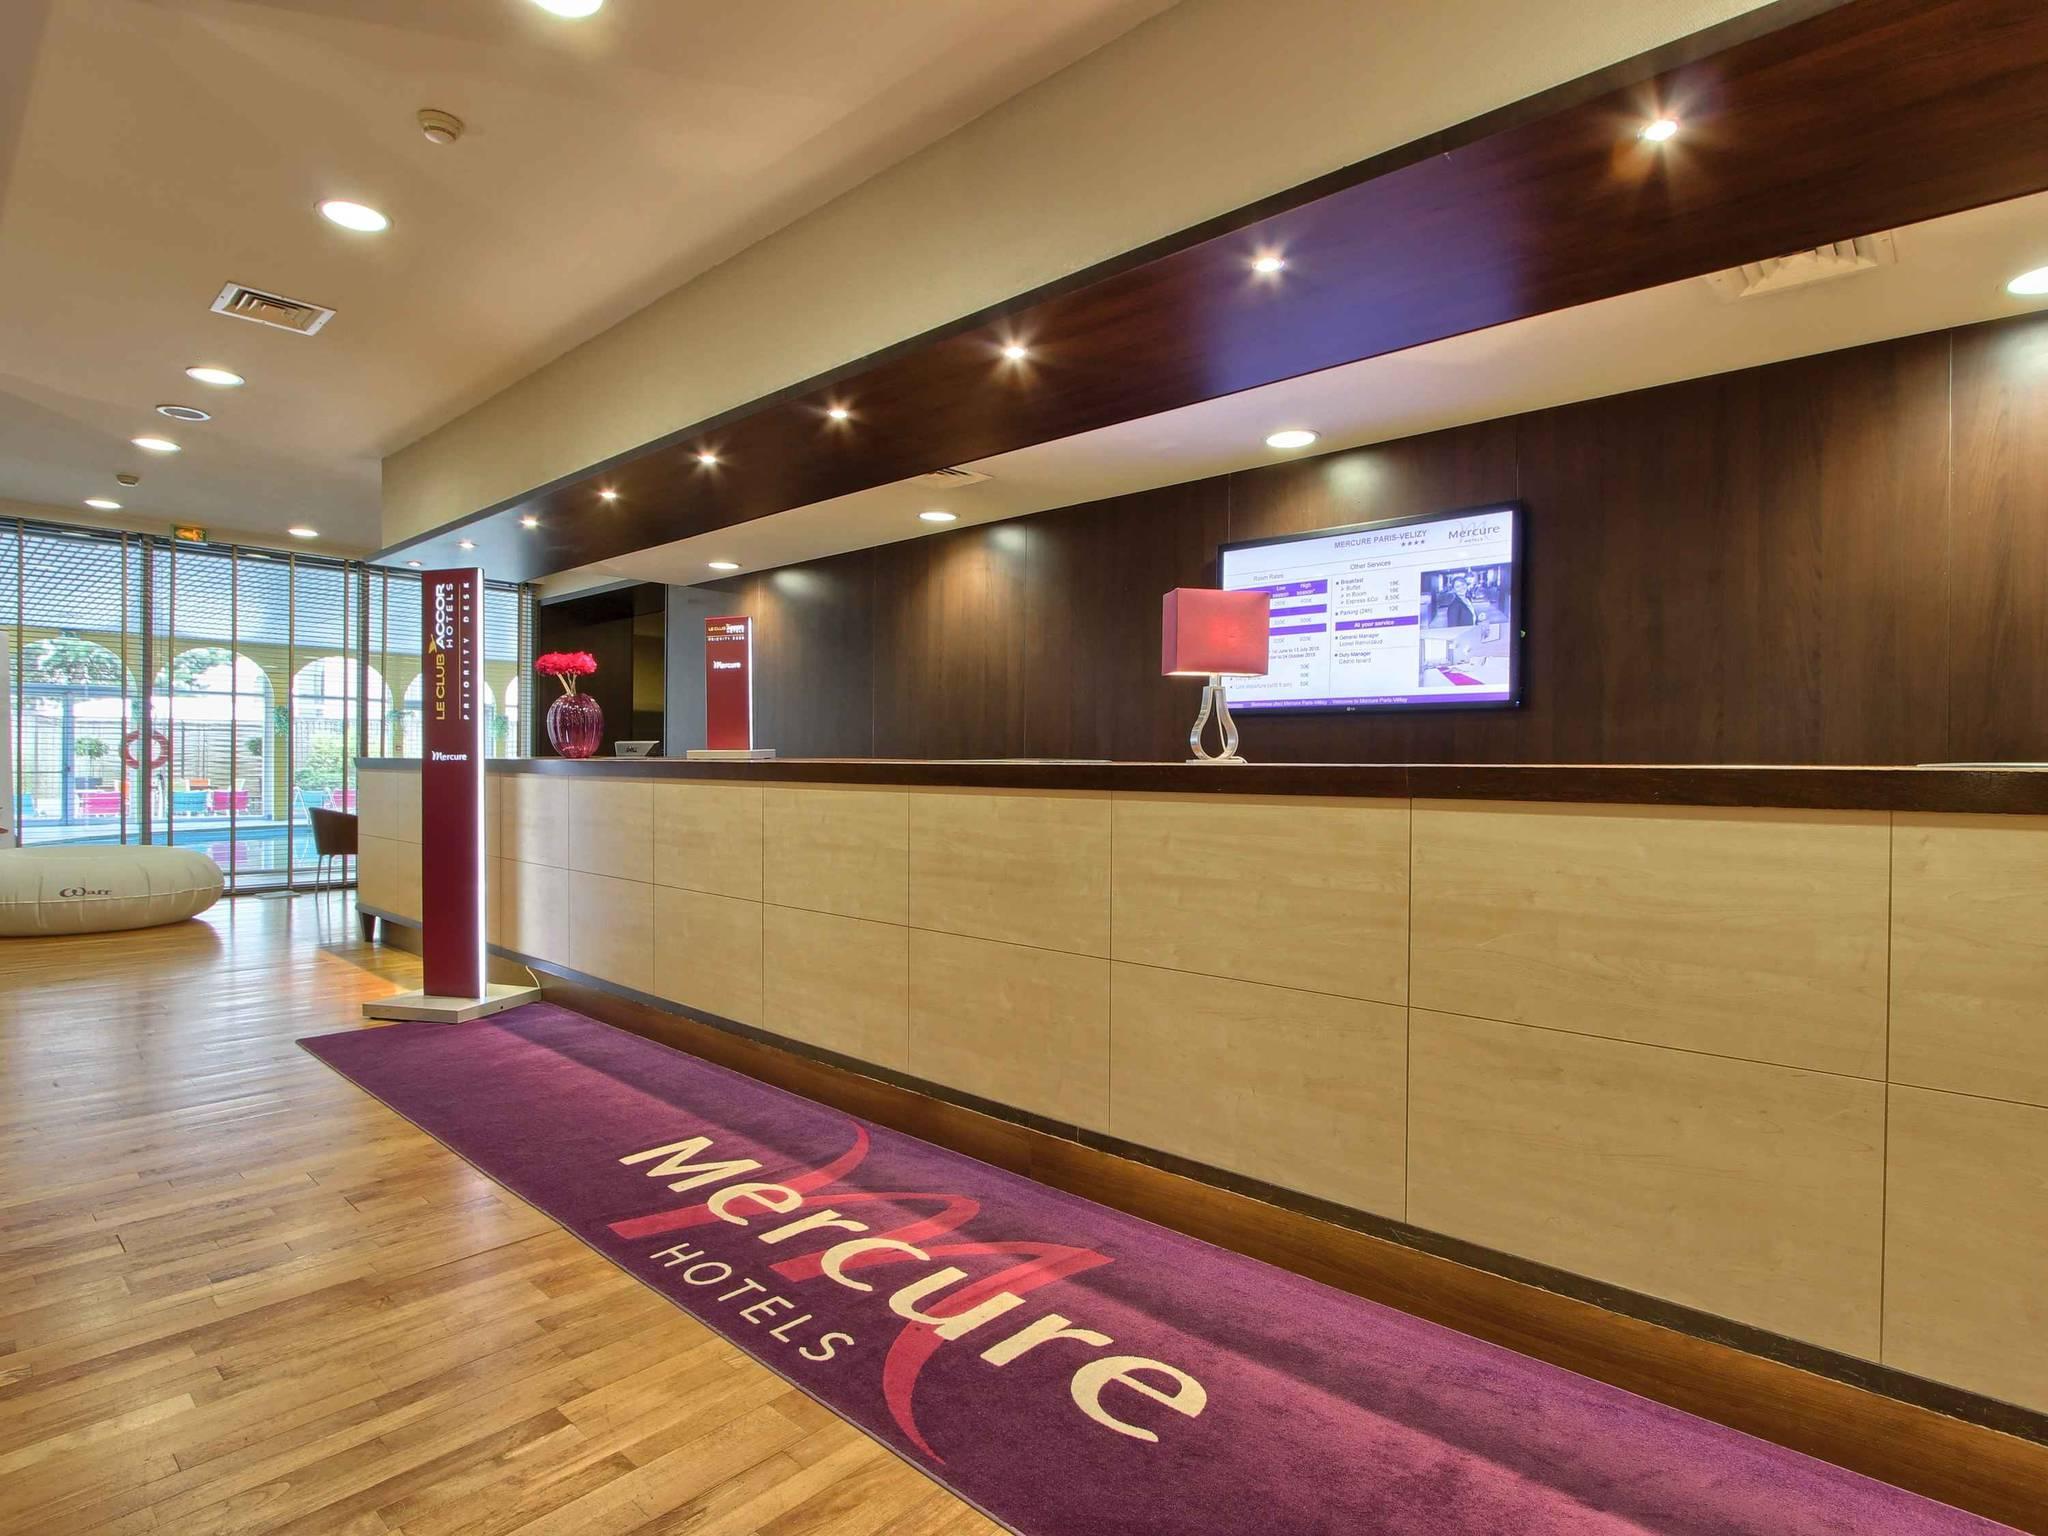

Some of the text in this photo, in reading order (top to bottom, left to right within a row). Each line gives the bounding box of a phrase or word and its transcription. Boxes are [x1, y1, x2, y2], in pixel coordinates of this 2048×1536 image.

[1334, 529, 1428, 549] MERCURE PARIS-VELIZY
[1448, 525, 1501, 540] Mercure
[1350, 560, 1392, 571] Other Services
[1340, 577, 1364, 585] Breakfast
[445, 583, 454, 649] HOTELS
[1361, 621, 1375, 629] your
[1358, 632, 1380, 640] Manager
[435, 583, 446, 720] LE CLUB ACCOR
[712, 660, 741, 670] Mercure
[431, 750, 468, 761] Mercure
[618, 1136, 1208, 1443] Mercure
[650, 1242, 856, 1362] HOTELS
